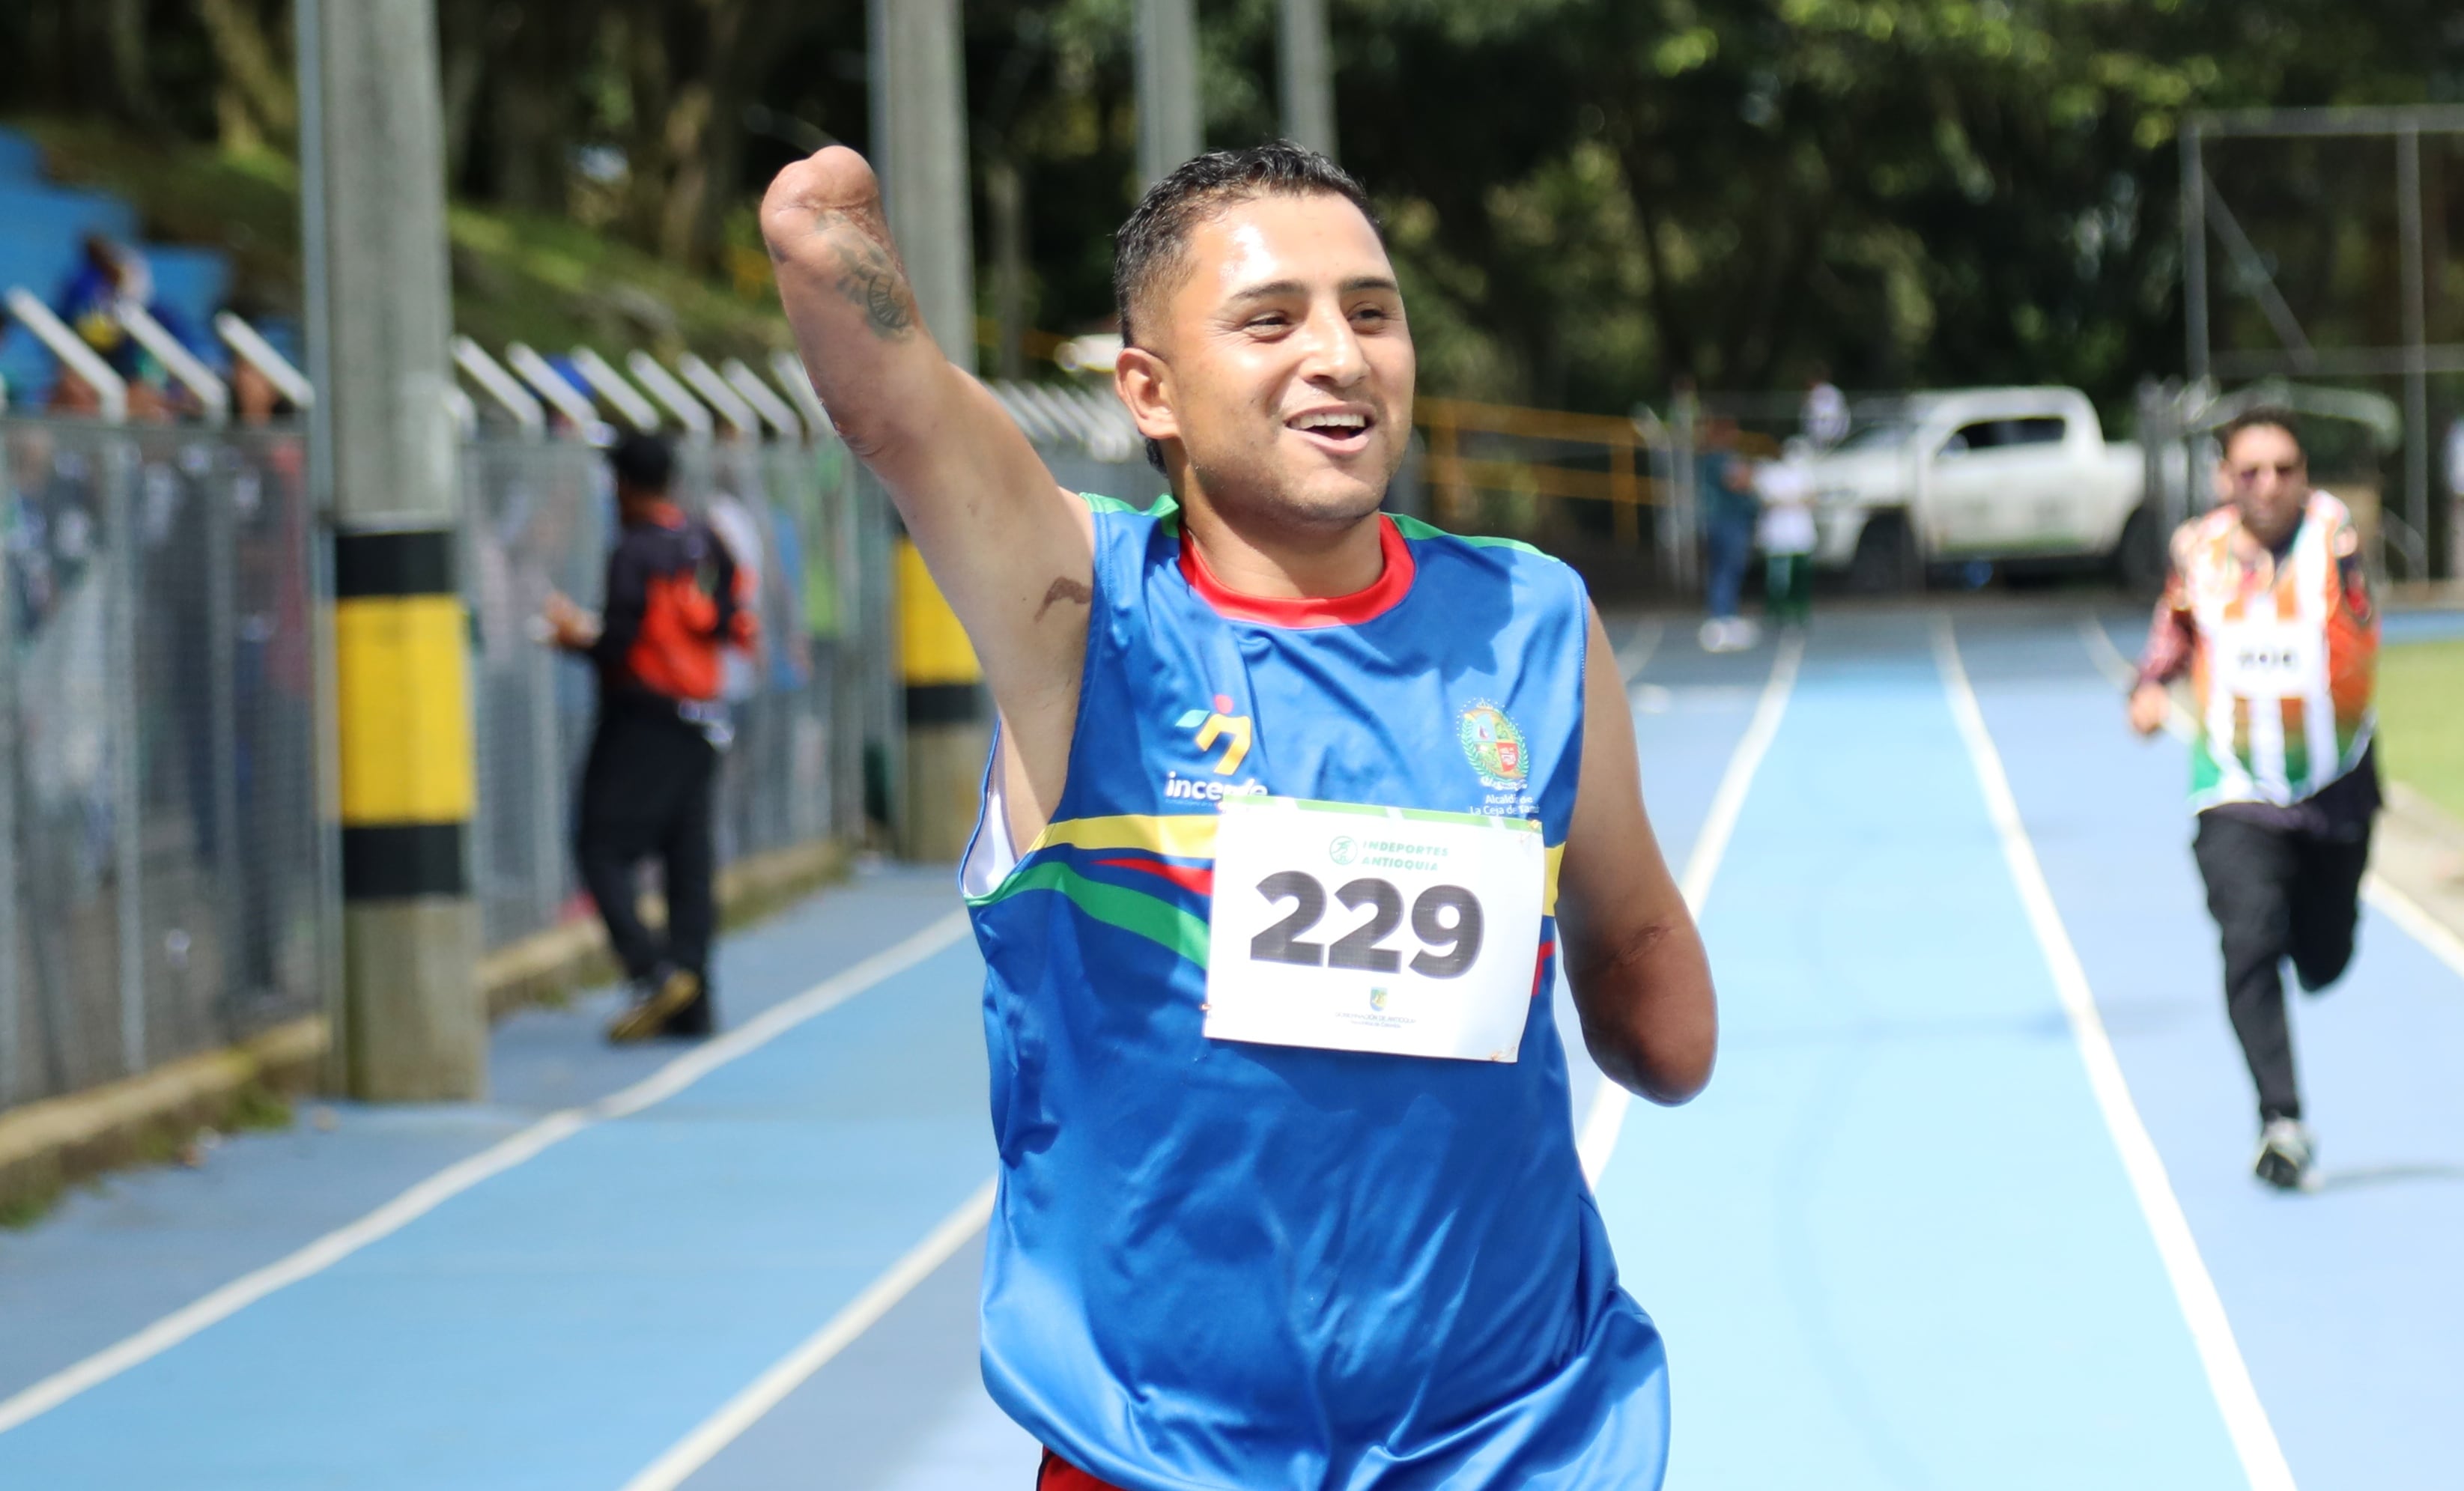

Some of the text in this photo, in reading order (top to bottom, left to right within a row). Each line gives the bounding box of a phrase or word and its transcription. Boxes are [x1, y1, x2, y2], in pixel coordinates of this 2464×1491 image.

[1362, 840, 1449, 857] INDEPORTES
[1362, 856, 1439, 871] ANTIOQUIA
[1250, 869, 1484, 980] 229
